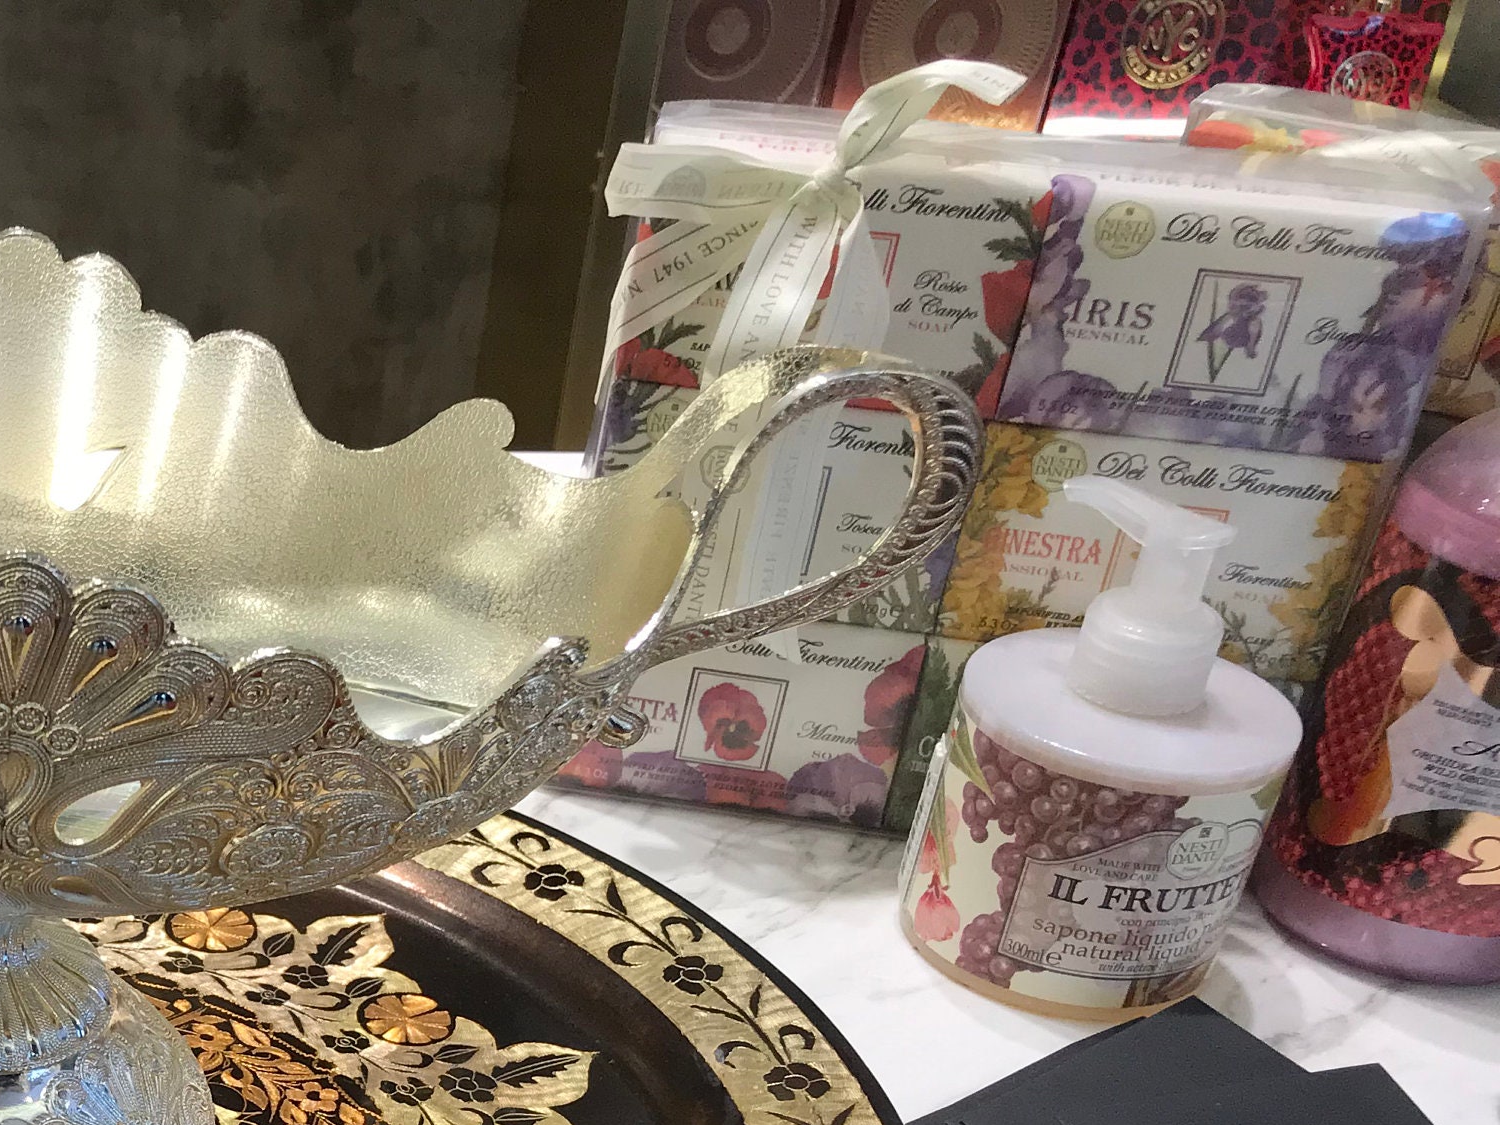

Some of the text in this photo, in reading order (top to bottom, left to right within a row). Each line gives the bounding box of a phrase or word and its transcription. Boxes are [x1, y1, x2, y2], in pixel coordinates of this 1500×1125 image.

[864, 187, 889, 212] lli
[1160, 211, 1221, 245] Dei
[1230, 215, 1295, 251] Colli
[653, 252, 695, 284] 1947
[1069, 298, 1157, 331] IRIS
[1092, 451, 1344, 502] Dei Colli Fiorentini
[1170, 851, 1220, 866] DANTE
[1177, 838, 1224, 852] NESTI
[1047, 873, 1090, 906] IL
[1032, 917, 1117, 948] sapone
[1122, 924, 1199, 954] liquido
[1061, 940, 1143, 963] natural
